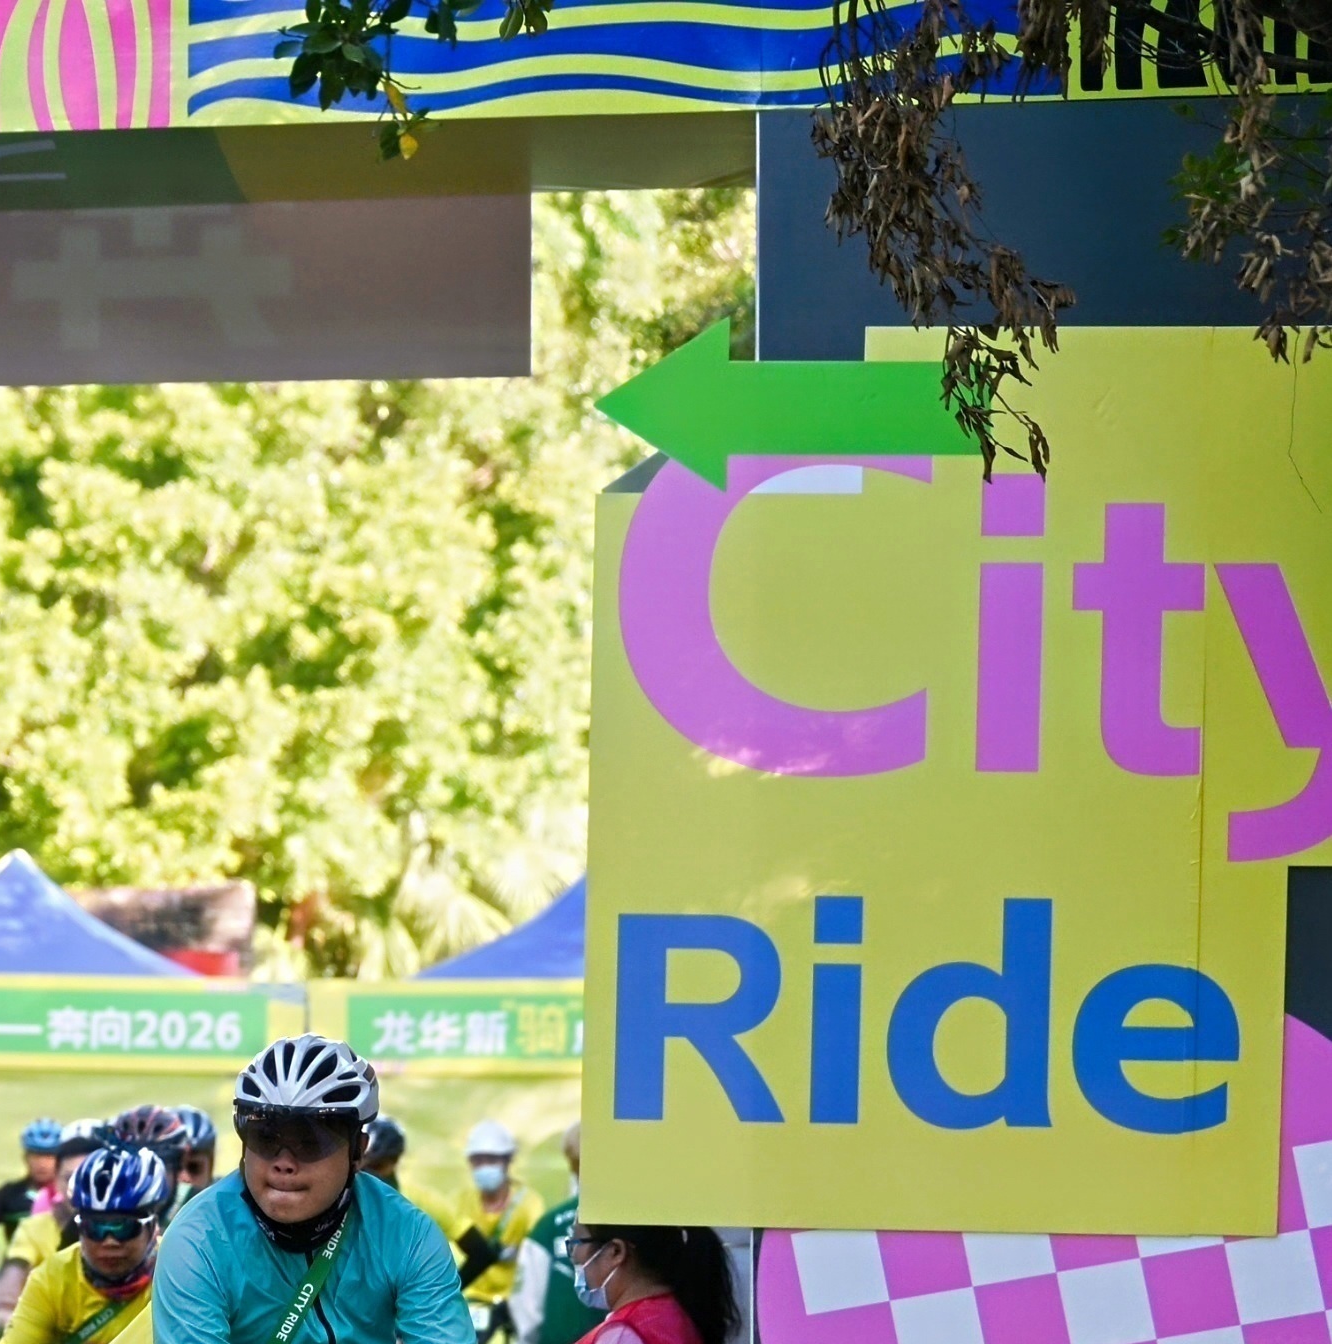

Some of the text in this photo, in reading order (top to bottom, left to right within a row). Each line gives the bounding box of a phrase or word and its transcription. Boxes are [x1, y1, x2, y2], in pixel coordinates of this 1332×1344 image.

[613, 895, 1241, 1136] Ride
[276, 1282, 314, 1342] CITY RIDE
